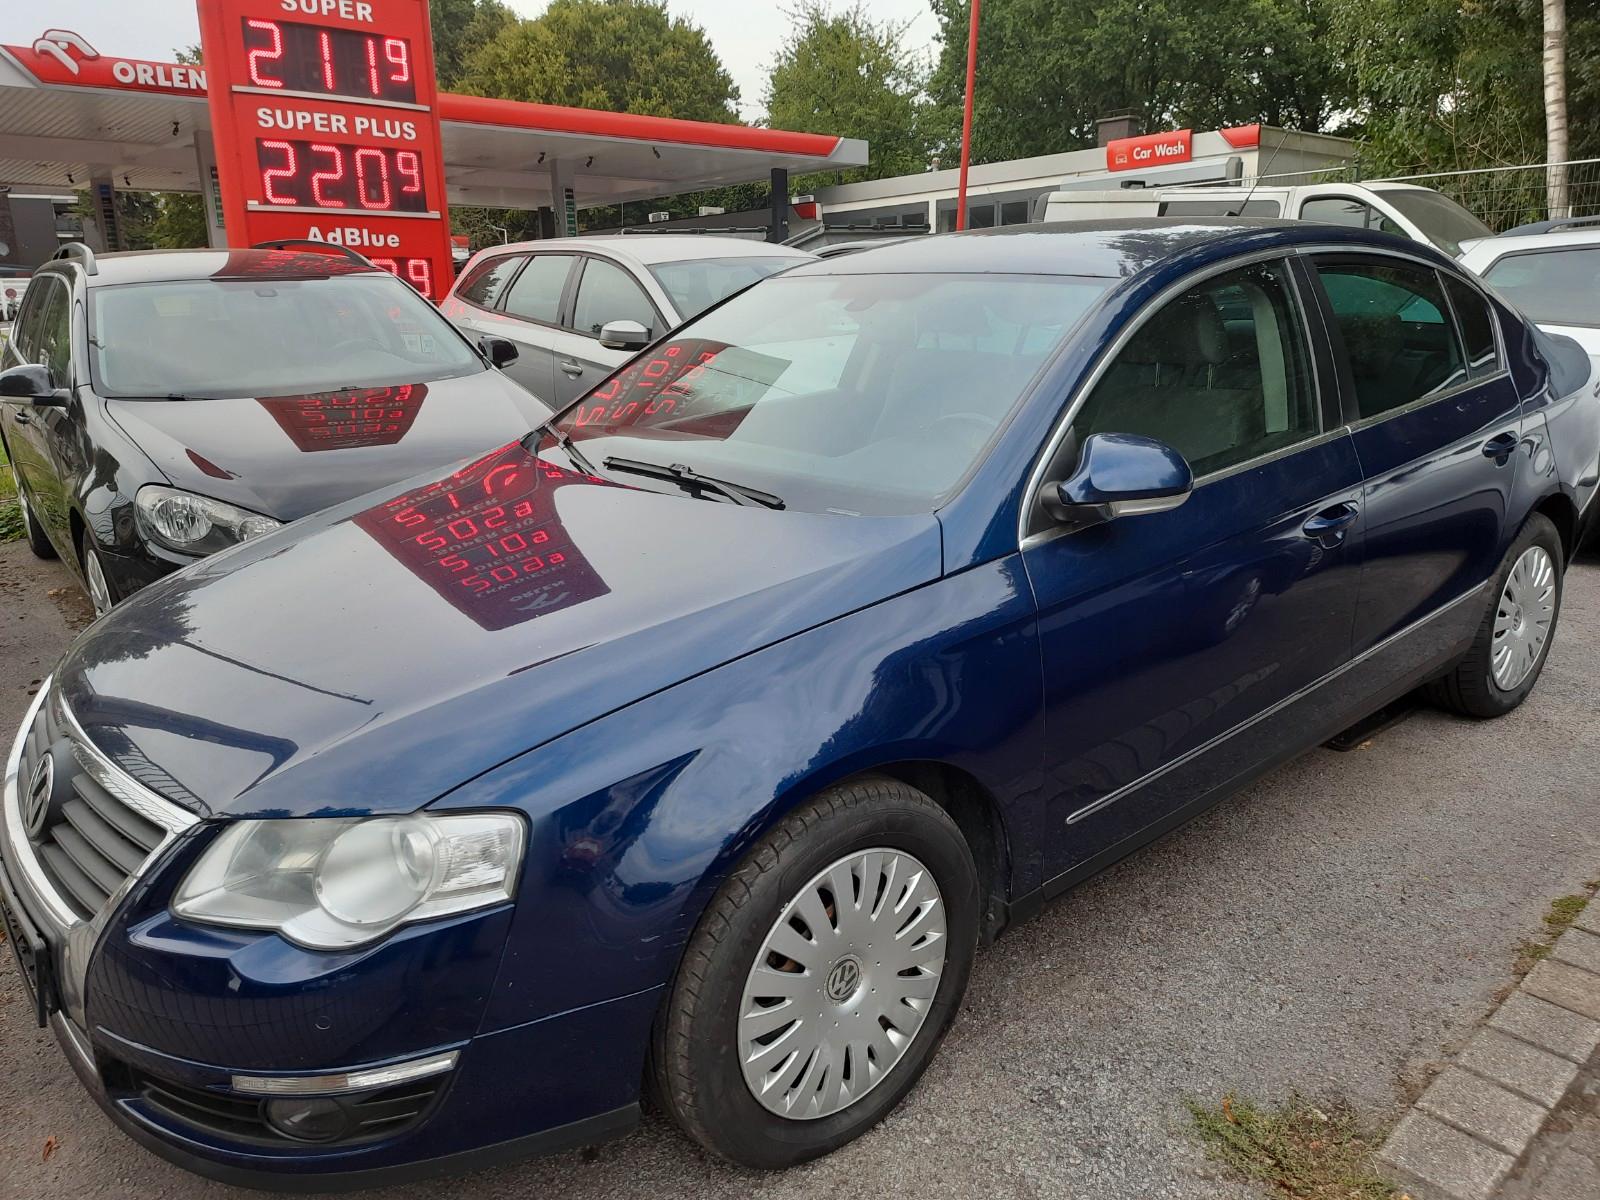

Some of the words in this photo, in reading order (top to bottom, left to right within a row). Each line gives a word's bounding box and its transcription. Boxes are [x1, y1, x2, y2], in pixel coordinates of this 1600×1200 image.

[280, 0, 374, 23] SUPER
[112, 60, 207, 90] ORLEN
[257, 107, 349, 135] SUPER
[355, 116, 417, 141] PLUS
[1133, 147, 1152, 160] Car
[1154, 140, 1184, 157] Wash
[307, 226, 401, 248] AdBlue
